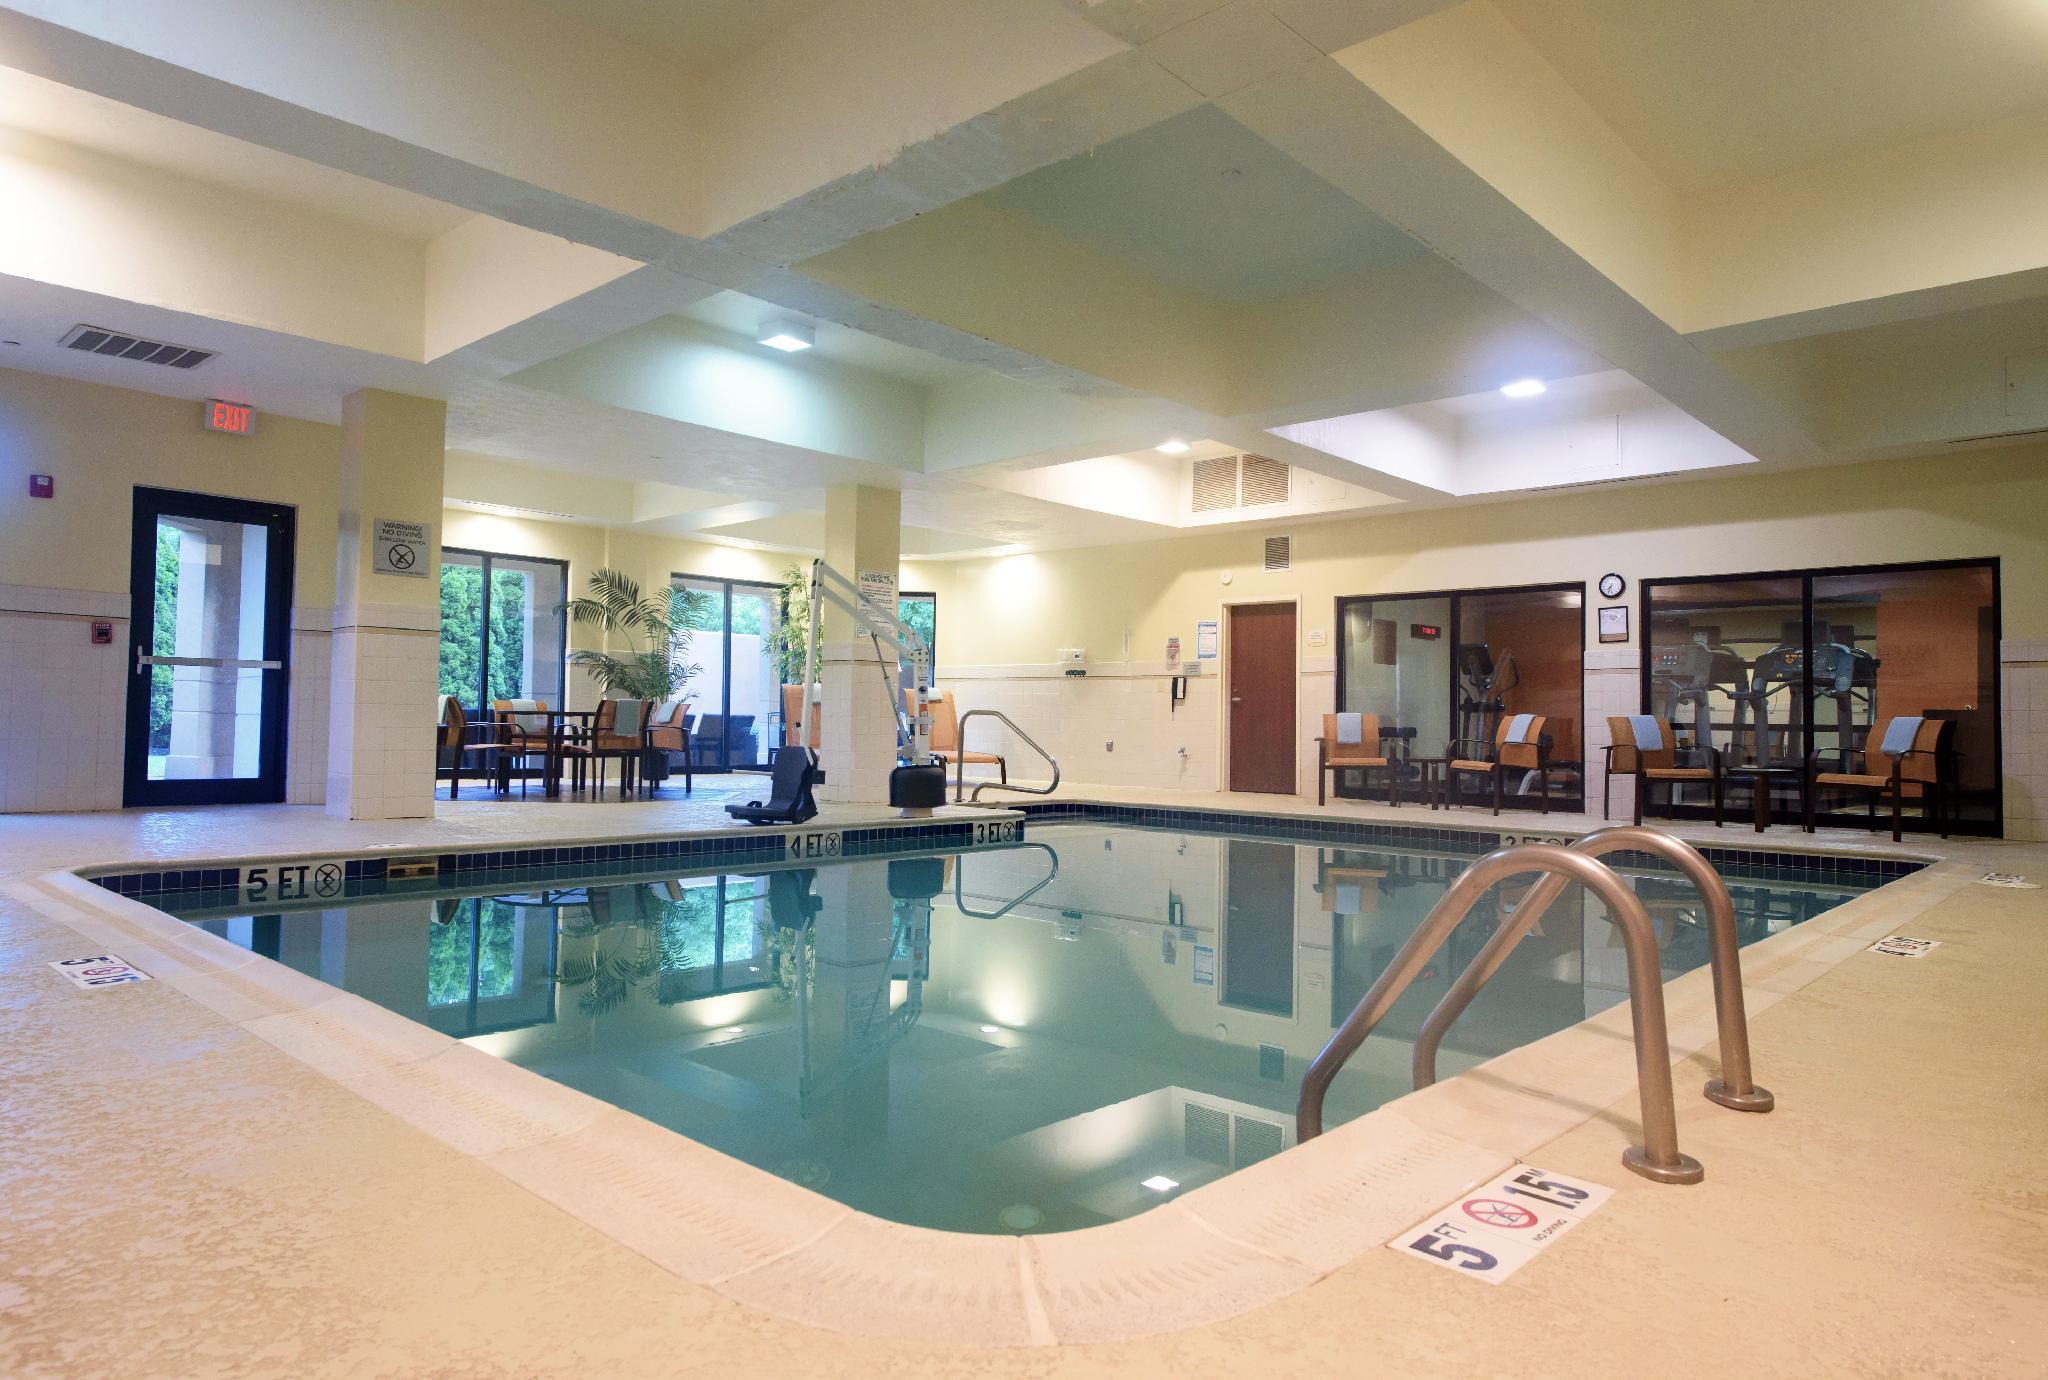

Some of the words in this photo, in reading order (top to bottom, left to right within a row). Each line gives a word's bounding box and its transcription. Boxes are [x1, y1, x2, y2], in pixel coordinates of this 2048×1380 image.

[213, 403, 251, 433] EXIT
[396, 530, 422, 539] DIVING
[247, 868, 268, 887] 5
[278, 865, 310, 886] FT
[1432, 1222, 1468, 1240] FT
[1532, 1233, 1547, 1241] NO
[1542, 1218, 1568, 1234] DIVING
[1408, 1233, 1498, 1271] 5
